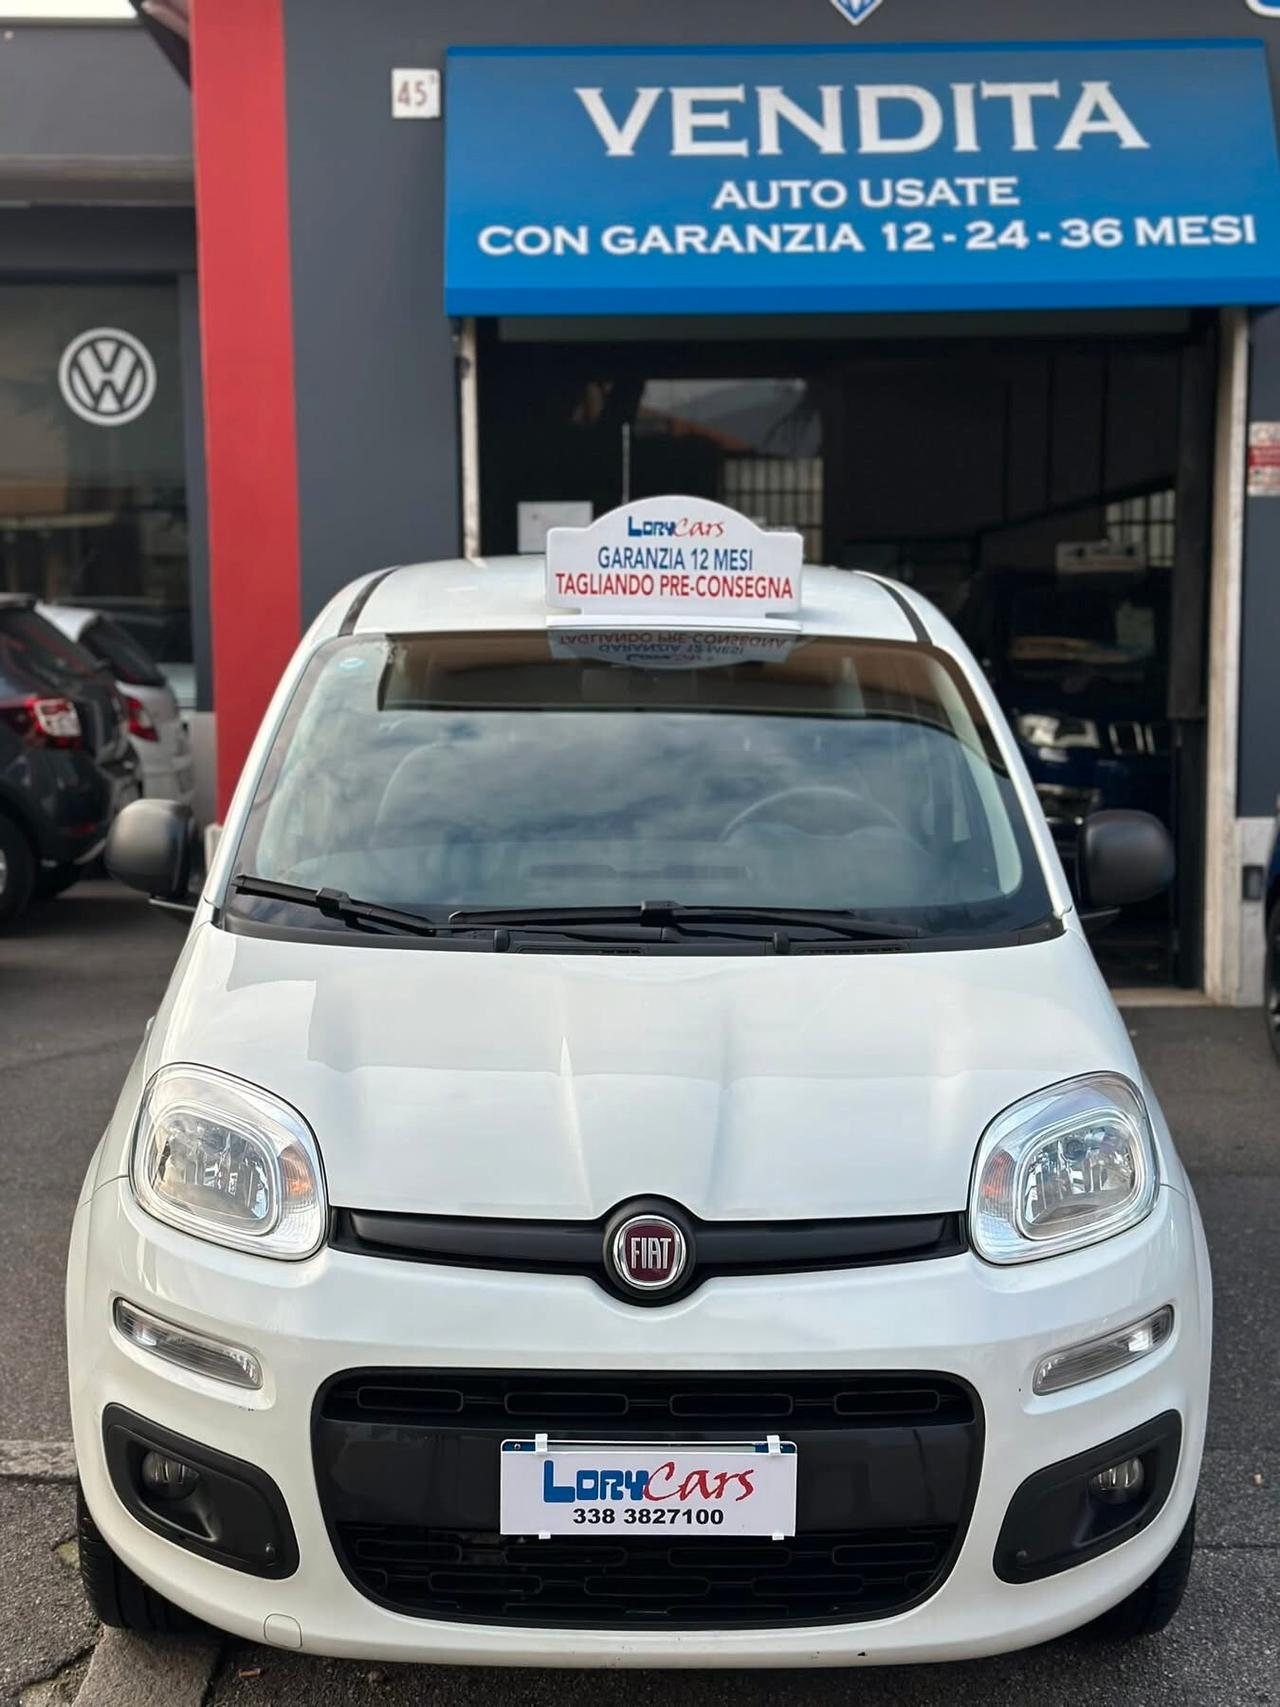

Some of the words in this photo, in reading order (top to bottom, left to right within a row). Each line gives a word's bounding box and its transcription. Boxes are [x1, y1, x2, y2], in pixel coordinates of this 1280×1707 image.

[575, 81, 1150, 158] VENDITA
[712, 179, 848, 211] AUTO
[859, 176, 1021, 209] USATE
[478, 225, 589, 256] CON
[601, 223, 865, 256] GARANZIA
[882, 221, 934, 251] 12
[966, 219, 1029, 250] 24
[1060, 217, 1123, 248] 36
[1134, 214, 1256, 246] MESI
[598, 547, 686, 570] GARANZIA
[691, 548, 709, 571] 12
[714, 548, 753, 571] MESI
[556, 573, 655, 596] TAGLIANDO
[660, 574, 793, 599] PRE-CONSEGNA
[630, 1237, 672, 1270] FIAT
[573, 1508, 616, 1525] 338
[623, 1508, 725, 1525] 3827100
